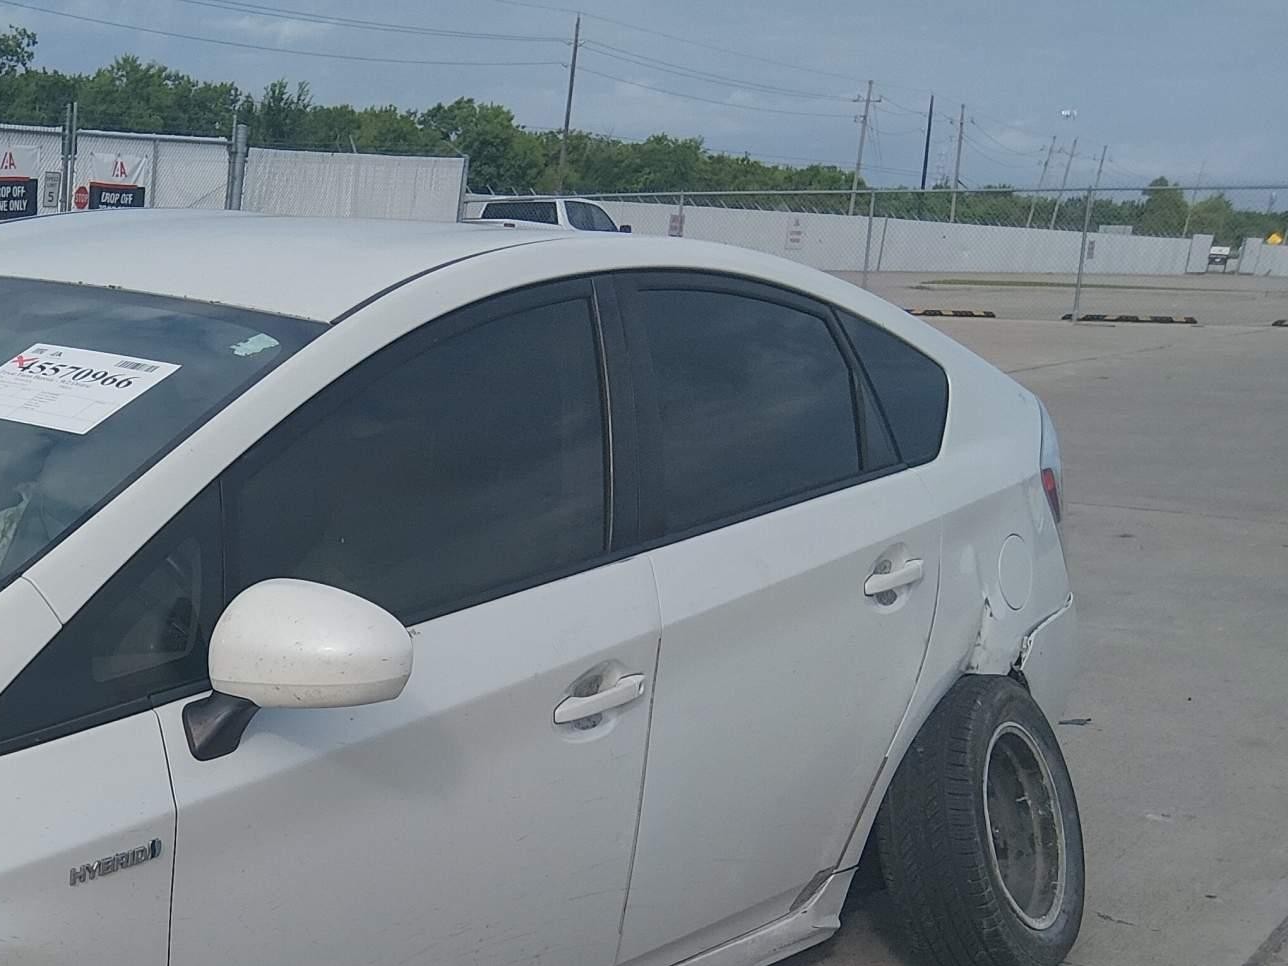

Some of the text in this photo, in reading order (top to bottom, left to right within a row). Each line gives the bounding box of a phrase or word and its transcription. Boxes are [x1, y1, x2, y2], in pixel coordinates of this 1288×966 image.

[12, 186, 26, 198] OFF
[47, 191, 55, 203] 5
[75, 193, 88, 203] STOP
[101, 191, 133, 204] DROP OFF
[9, 199, 28, 212] ONLY
[18, 360, 140, 389] 45570966
[69, 845, 149, 886] HYBRID
